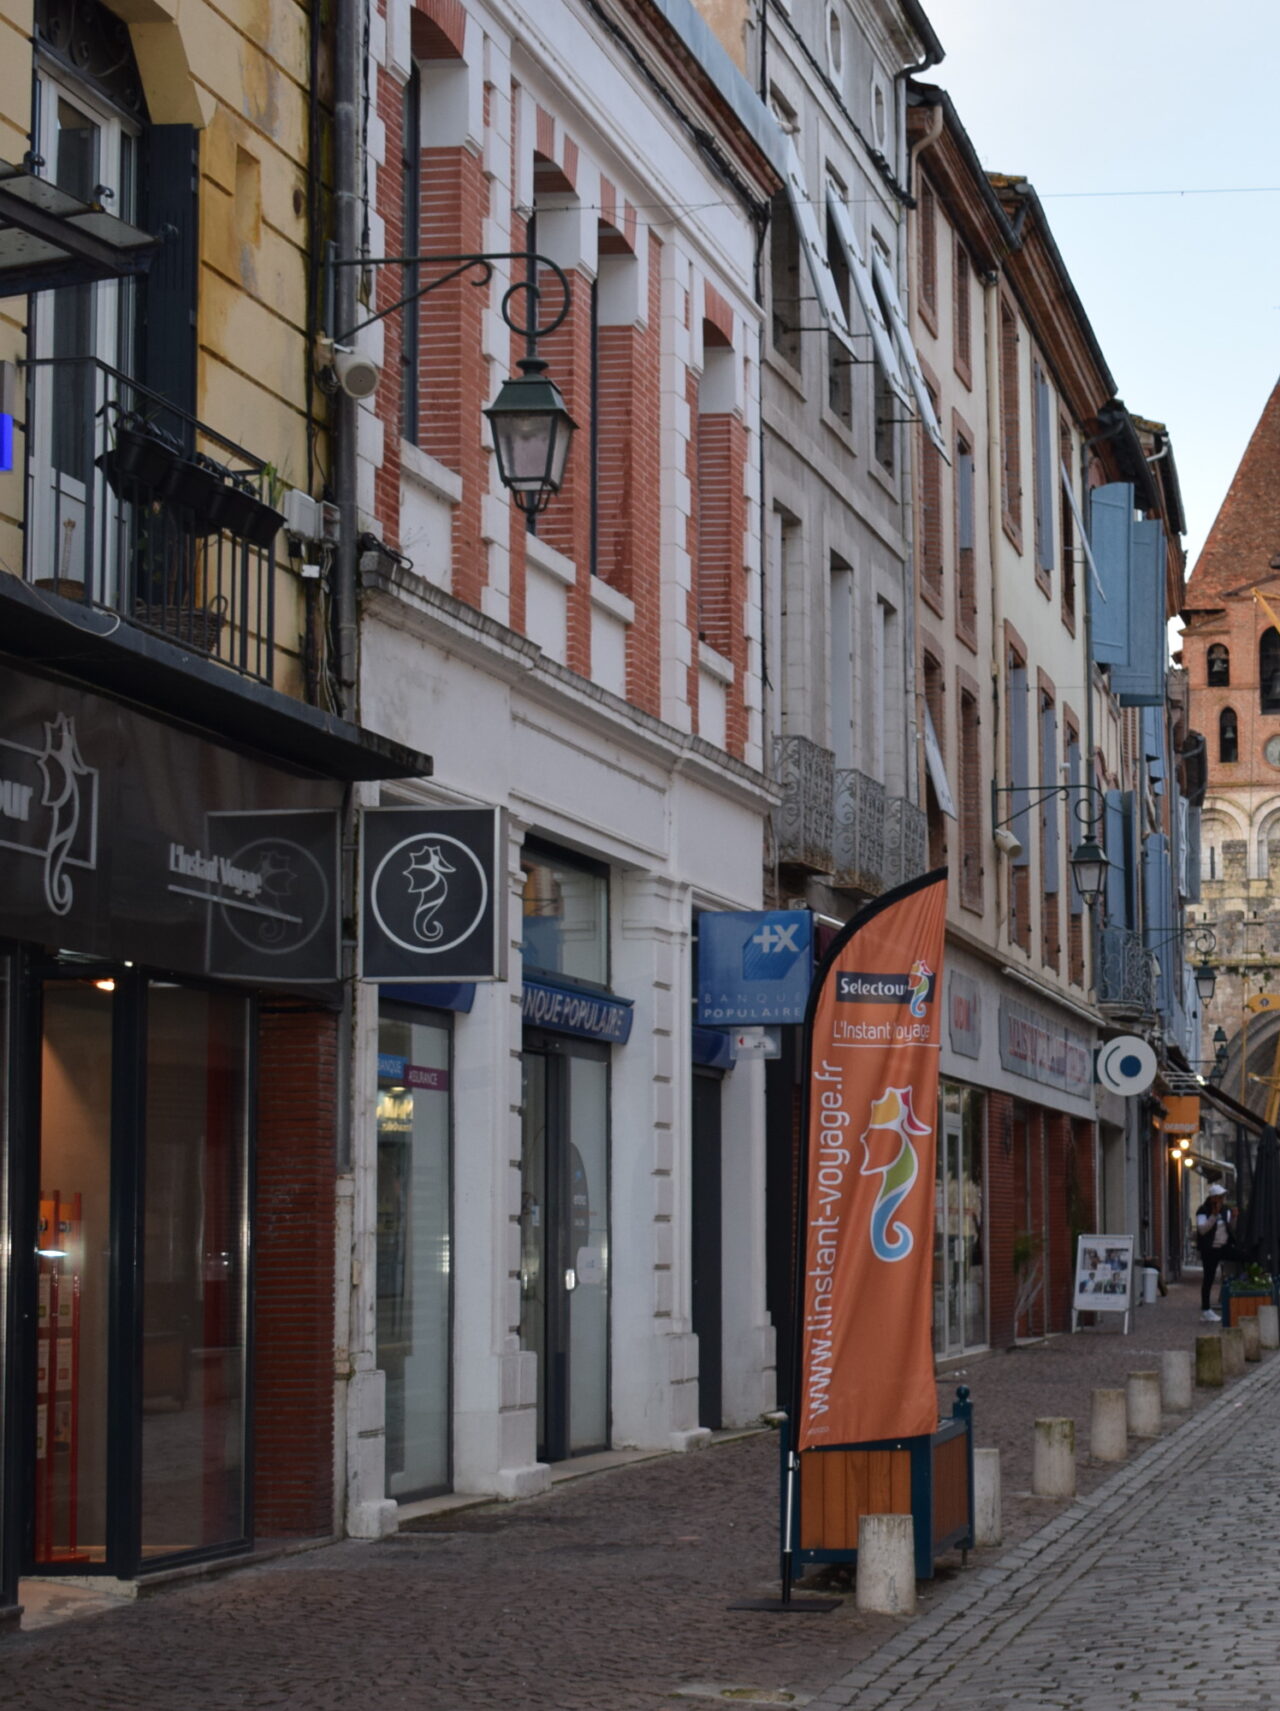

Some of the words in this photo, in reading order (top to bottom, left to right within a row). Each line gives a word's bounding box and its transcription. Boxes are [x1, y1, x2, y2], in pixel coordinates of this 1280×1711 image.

[840, 978, 908, 996] Selectou
[560, 996, 625, 1036] POPULAIRE
[704, 1008, 801, 1018] POPULAIRE
[833, 1020, 891, 1040] L'Instant
[894, 1023, 931, 1042] oyage
[807, 1059, 851, 1420] www.linstant-voyage.fr
